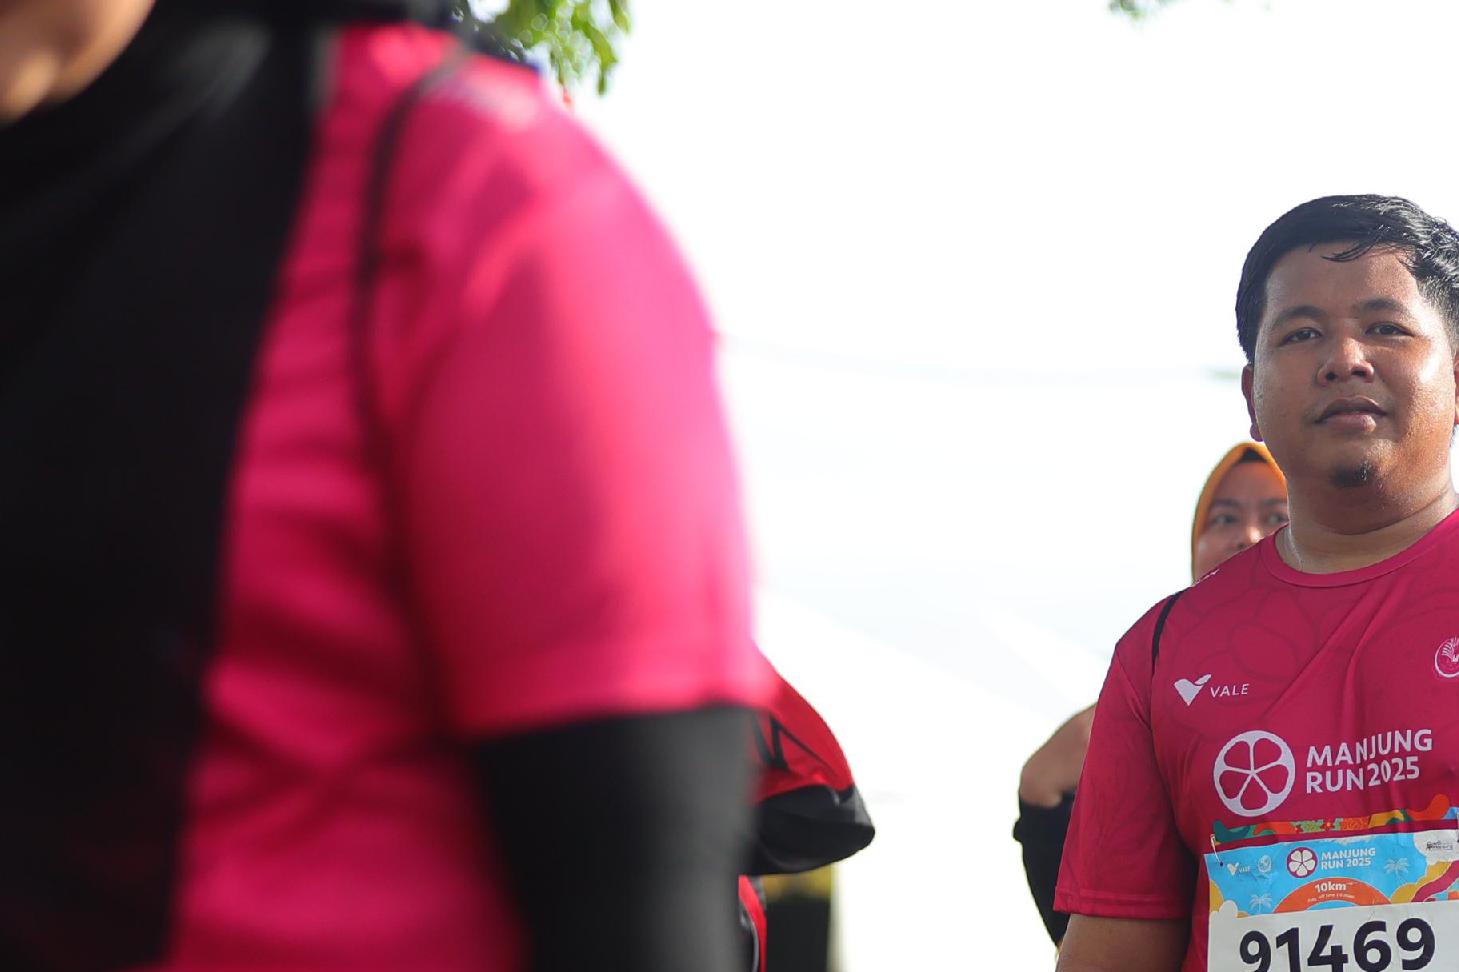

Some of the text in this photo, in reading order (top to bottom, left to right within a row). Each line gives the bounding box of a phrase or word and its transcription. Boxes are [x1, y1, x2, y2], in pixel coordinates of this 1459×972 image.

[1210, 683, 1249, 698] VALE
[1306, 729, 1433, 767] MANJUNG
[1306, 756, 1420, 793] RUN 2025
[1321, 847, 1376, 861] MANJUNG
[1321, 857, 1372, 870] RUN 2025
[1314, 881, 1347, 893] 10km
